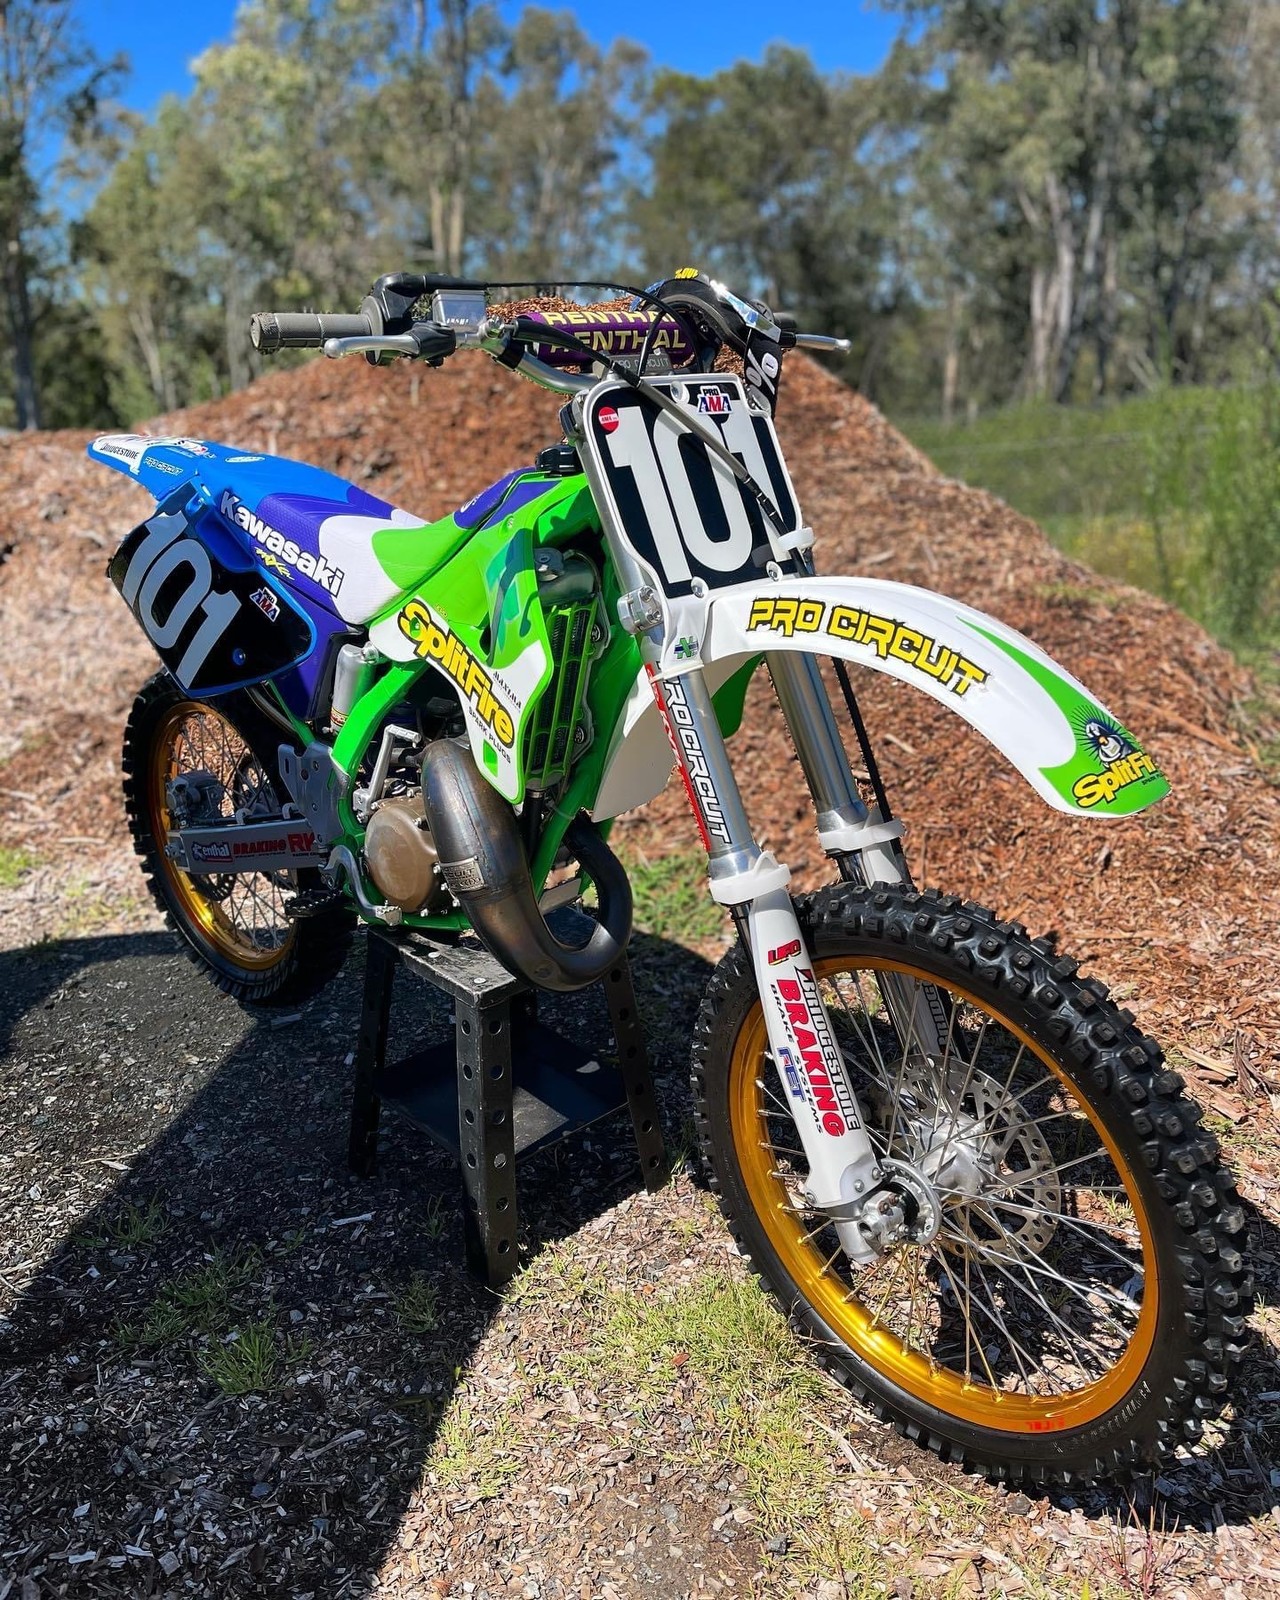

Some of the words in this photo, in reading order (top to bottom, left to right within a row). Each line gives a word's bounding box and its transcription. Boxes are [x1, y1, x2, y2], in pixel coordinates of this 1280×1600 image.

[550, 329, 686, 353] ENTHAL
[703, 388, 721, 396] PRO
[698, 396, 733, 413] AMA
[220, 489, 345, 599] Kawasaki
[604, 399, 792, 584] 101
[121, 510, 242, 689] 101
[747, 596, 827, 638] PRO
[826, 604, 990, 697] CIRCUIT
[397, 598, 515, 750] SplitFire
[469, 706, 487, 735] SPARK
[488, 732, 511, 764] PLUGS
[678, 727, 732, 844] CIRCUIT
[233, 839, 286, 855] BRAKING
[770, 984, 794, 1043] BRAKE
[793, 1055, 823, 1134] SYSTEMS
[776, 979, 845, 1137] BRAKING
[794, 966, 861, 1131] BRIDGESTONE
